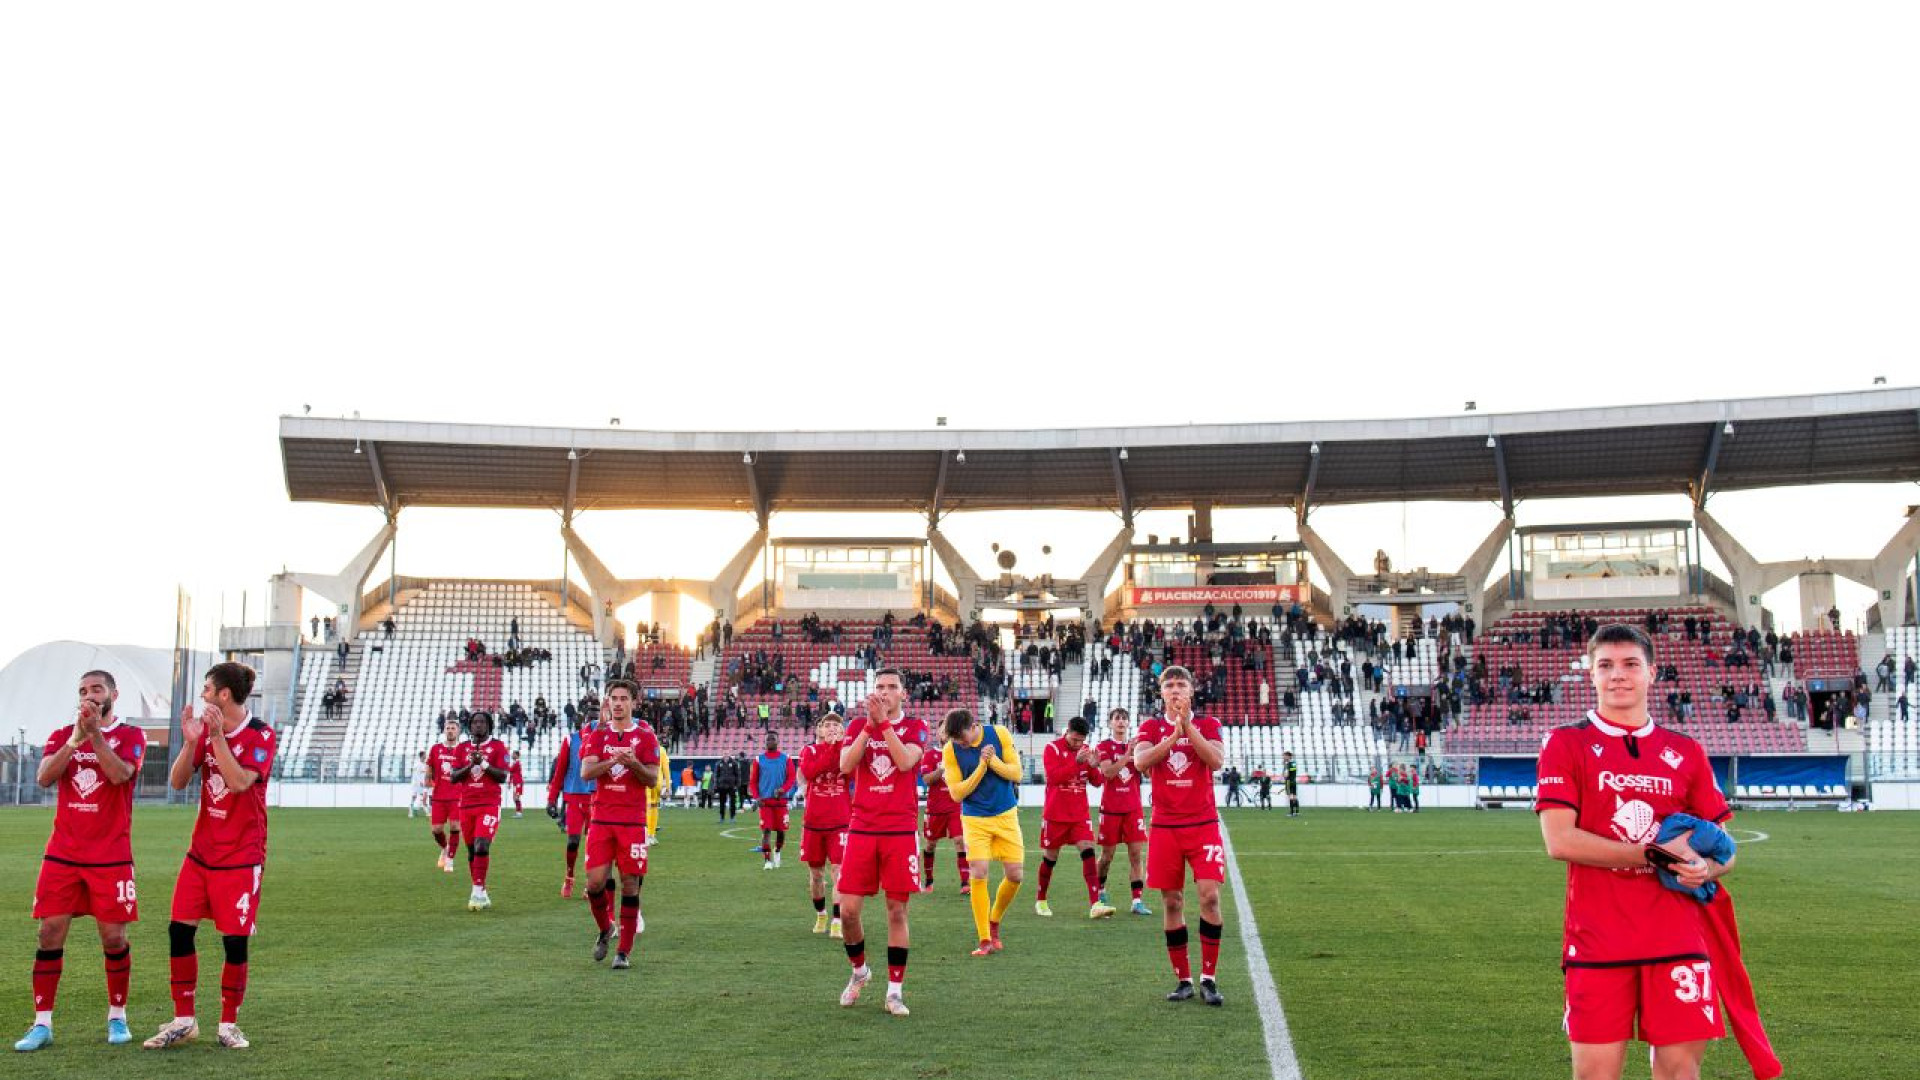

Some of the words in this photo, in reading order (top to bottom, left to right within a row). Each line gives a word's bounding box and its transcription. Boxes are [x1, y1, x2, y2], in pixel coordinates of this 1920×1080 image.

[1598, 770, 1672, 792] ROSSETTI
[630, 843, 648, 859] 55
[1202, 845, 1224, 862] 72
[116, 880, 136, 903] 16
[236, 892, 250, 914] 4
[1670, 961, 1711, 1003] 37
